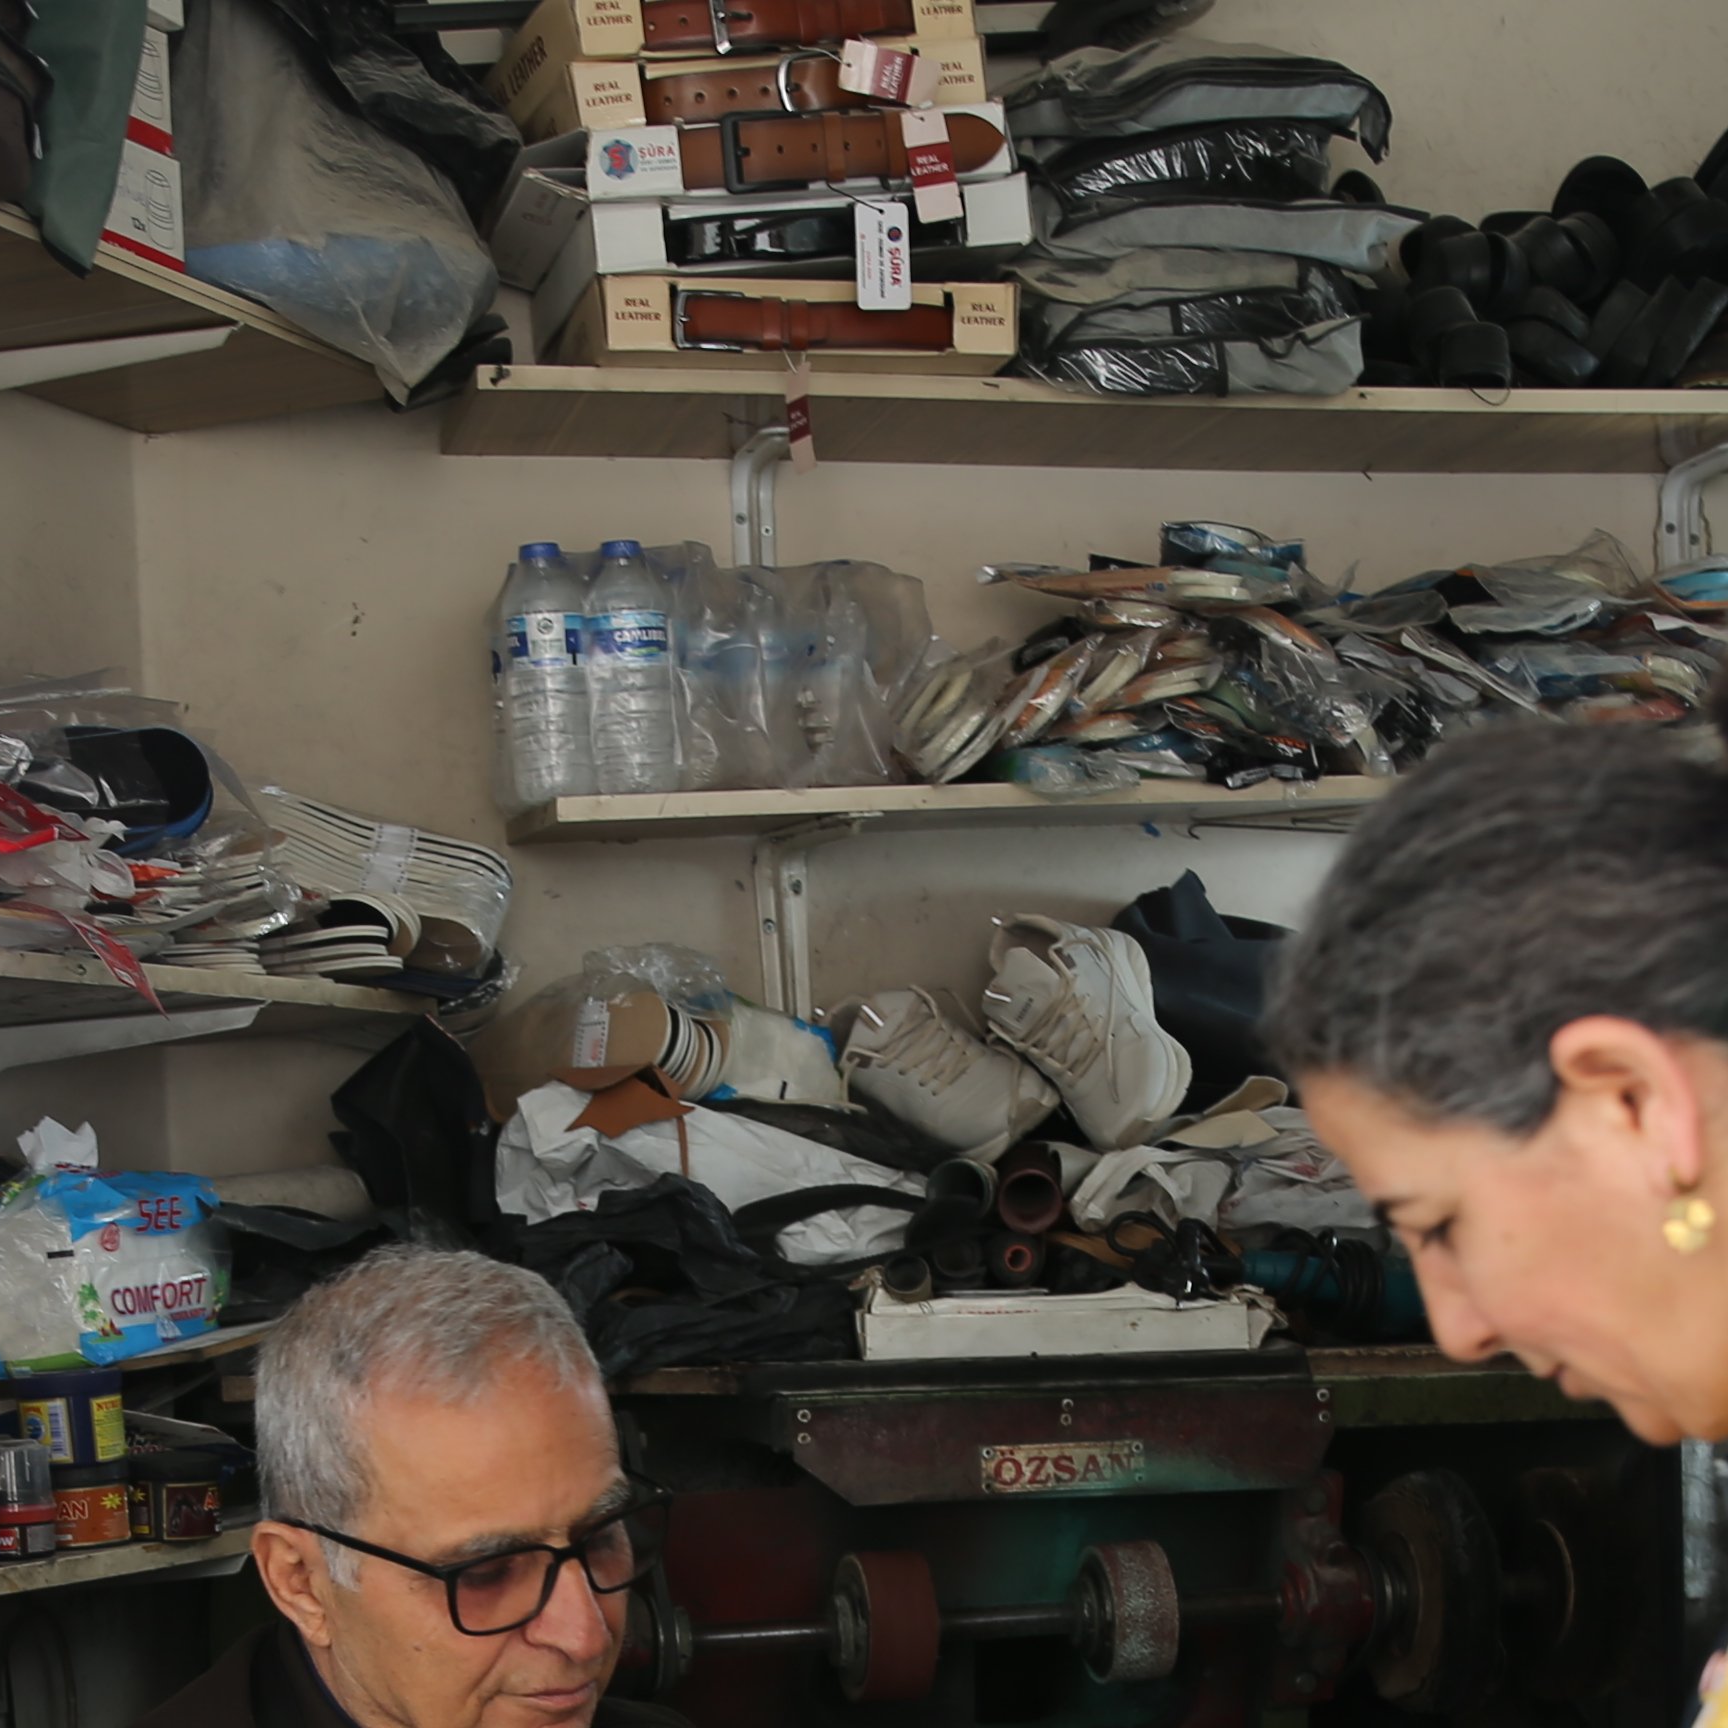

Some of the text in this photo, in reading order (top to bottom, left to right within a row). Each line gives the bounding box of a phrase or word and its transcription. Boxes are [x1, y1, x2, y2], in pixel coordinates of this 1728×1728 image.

[595, 1, 622, 11] REAL
[920, 5, 964, 16] LEATHER
[587, 15, 633, 27] LEATHER
[507, 35, 549, 97] LEATHER
[593, 80, 621, 92] REAL
[585, 93, 633, 108] LEATHER
[917, 154, 940, 164] REAL
[910, 162, 950, 177] LEATHER
[624, 298, 651, 308] REAL
[971, 303, 996, 313] REAL
[615, 311, 662, 321] LEATHER
[960, 316, 1006, 327] LEATHER
[135, 1196, 182, 1232] SEE
[110, 1277, 208, 1316] COMFORT
[993, 1449, 1135, 1486] ÖZSAN
